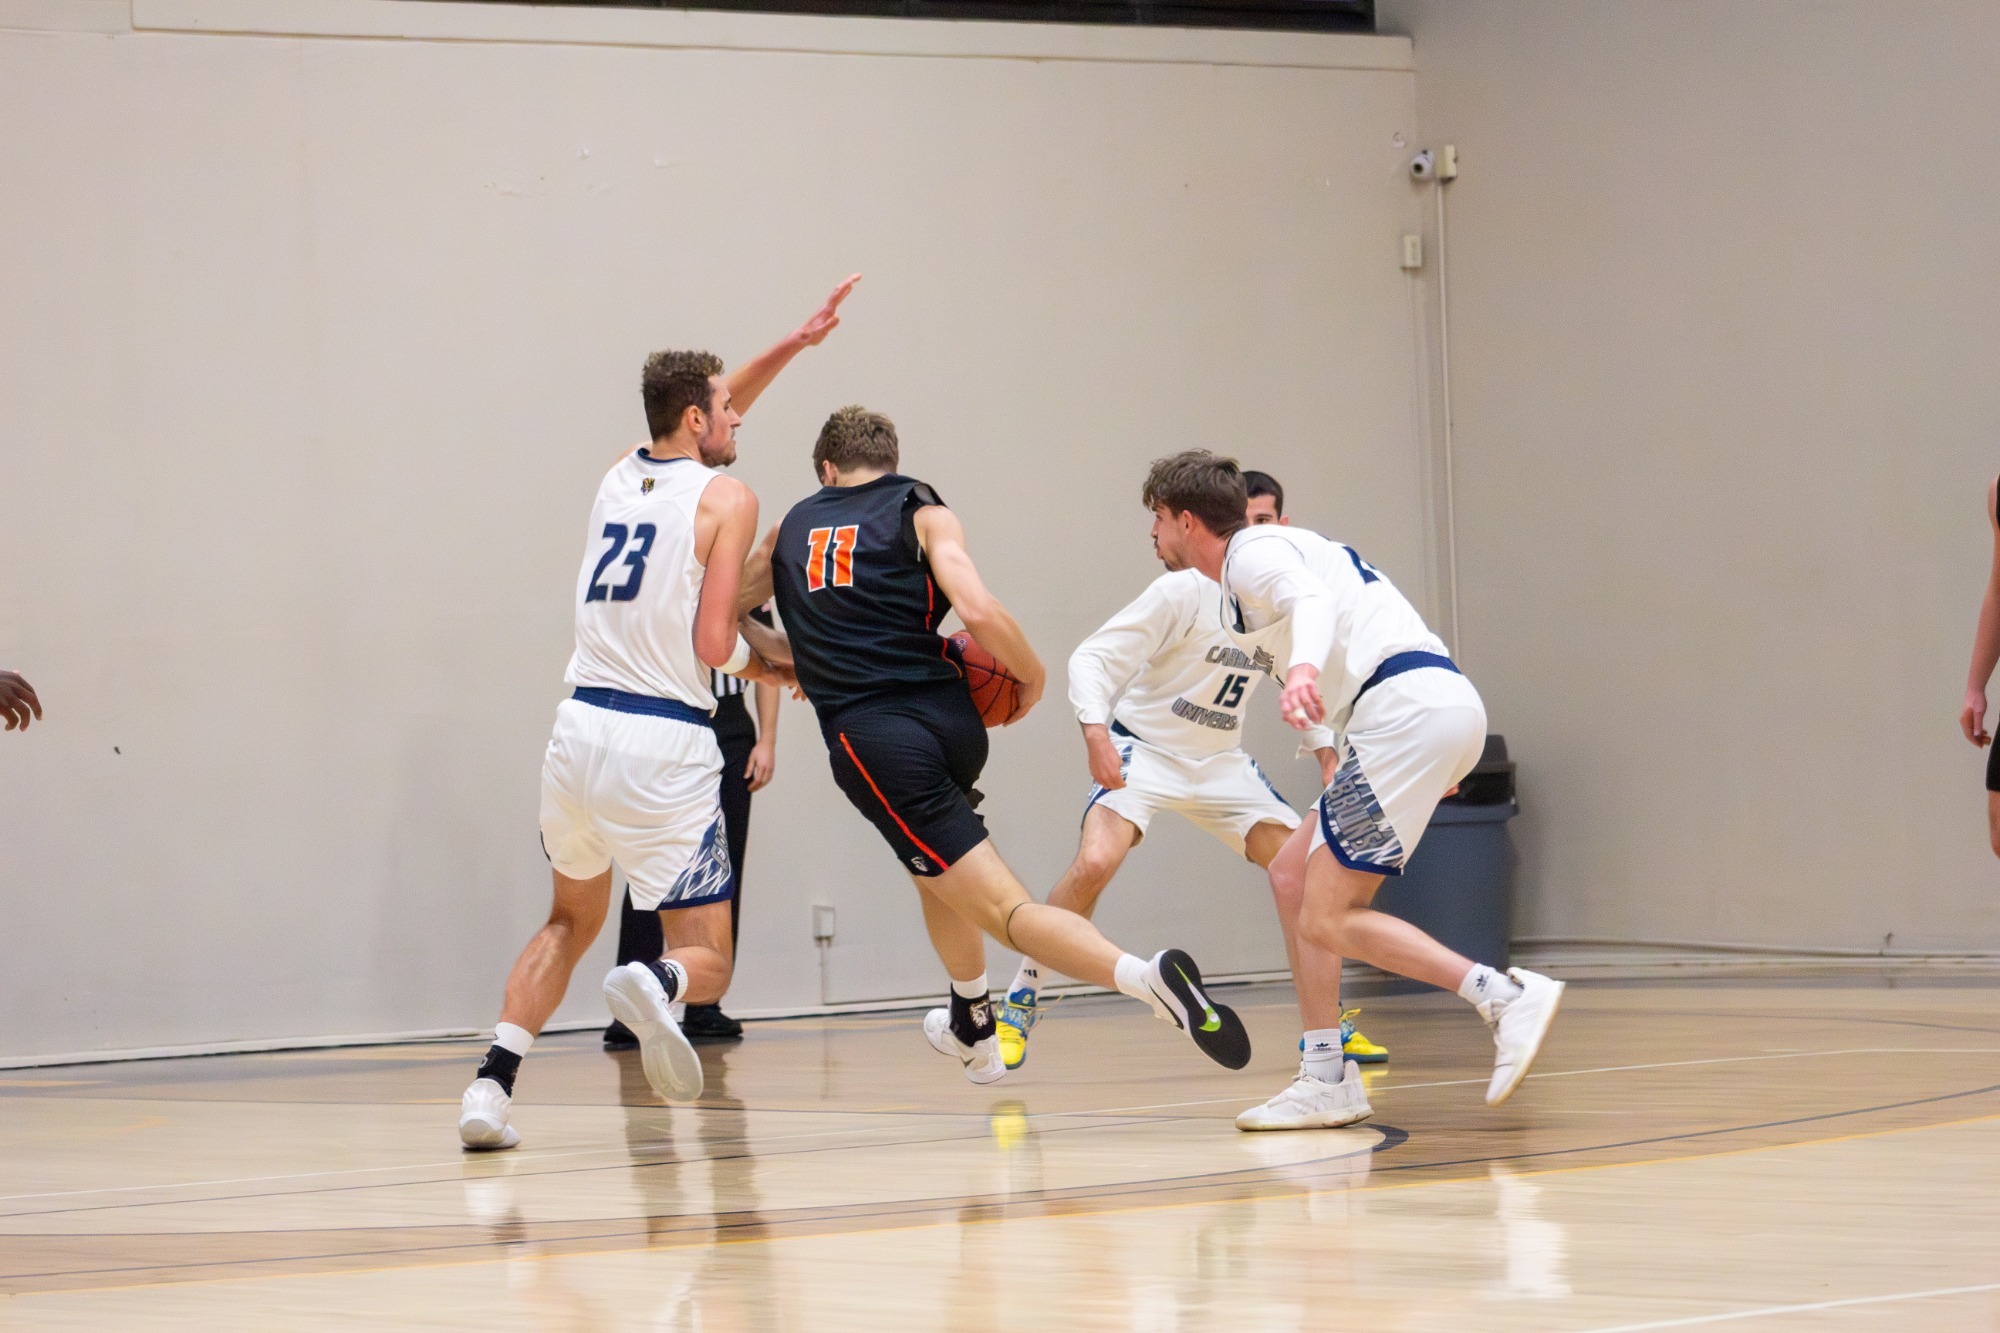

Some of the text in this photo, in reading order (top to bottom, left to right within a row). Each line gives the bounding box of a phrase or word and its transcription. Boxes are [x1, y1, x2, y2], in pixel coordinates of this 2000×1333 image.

[585, 522, 656, 604] 23
[806, 524, 860, 592] 11
[1171, 697, 1239, 731] UNIVERS
[1212, 673, 1250, 709] 15
[1328, 779, 1385, 852] BRUINS
